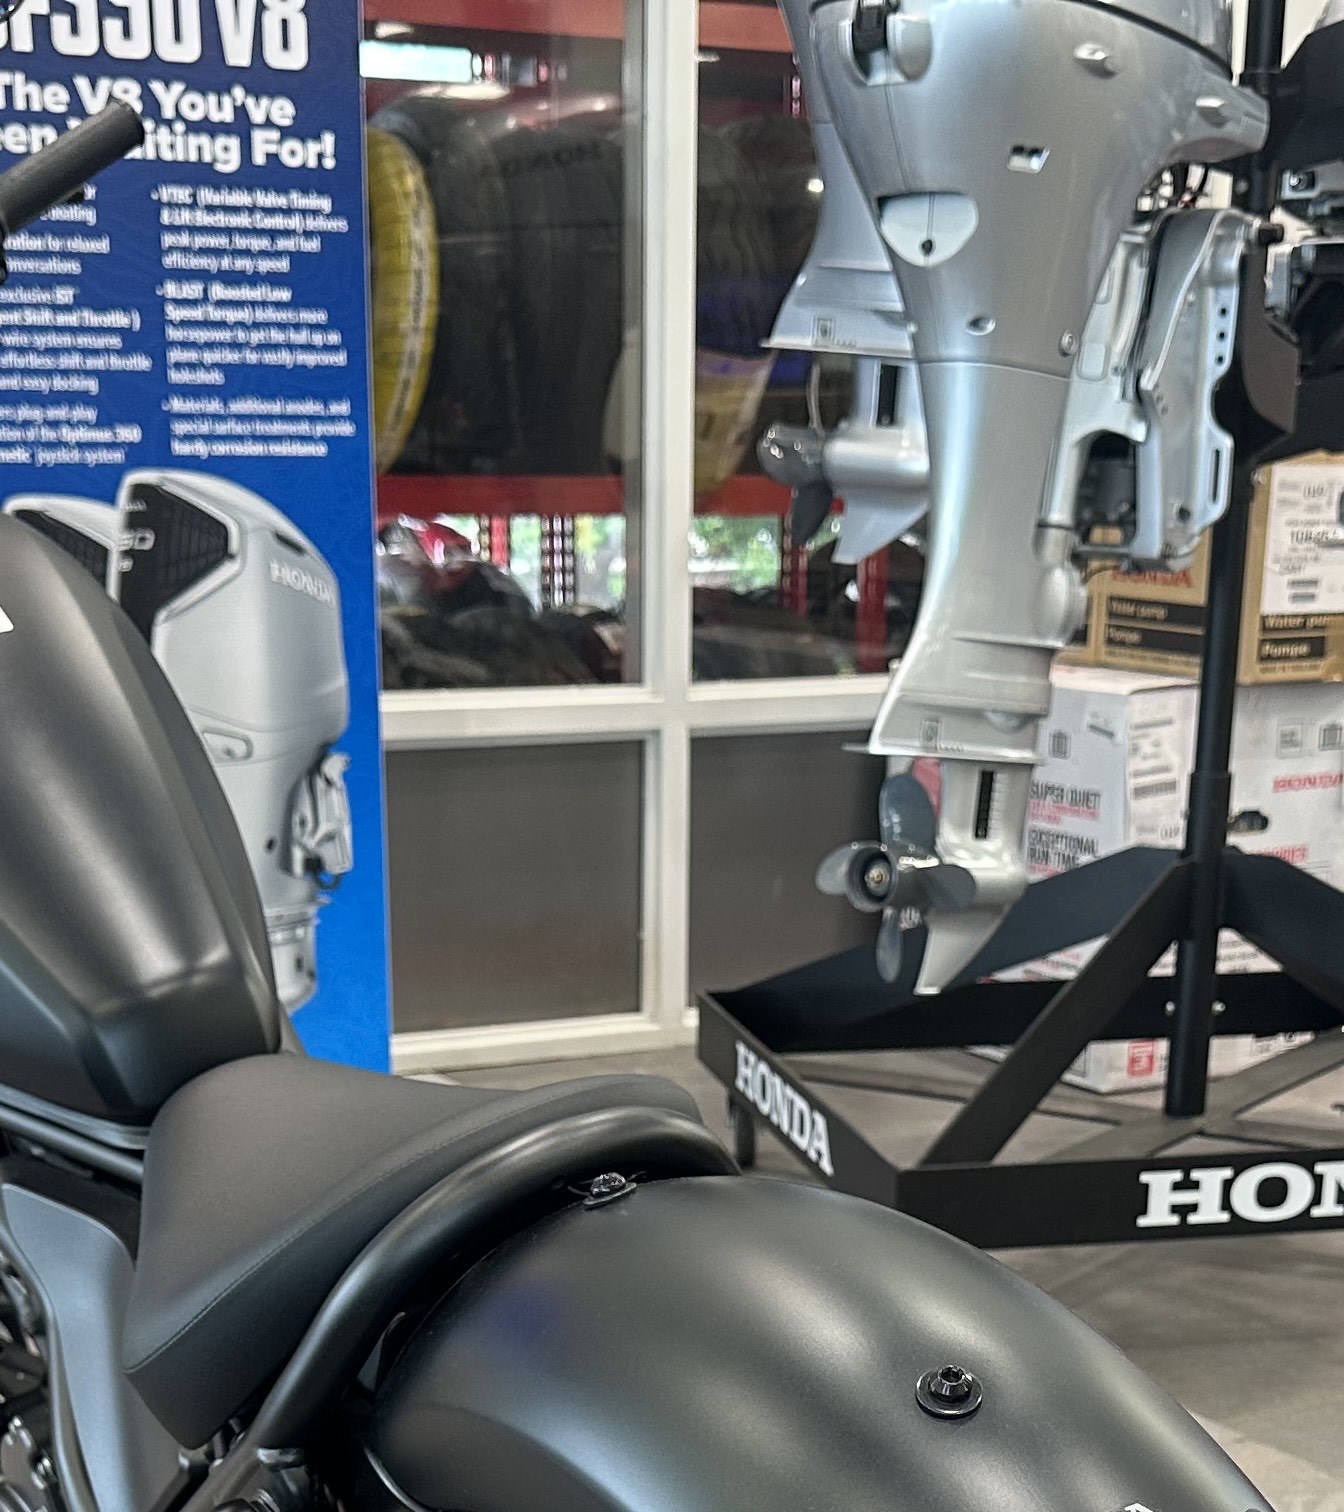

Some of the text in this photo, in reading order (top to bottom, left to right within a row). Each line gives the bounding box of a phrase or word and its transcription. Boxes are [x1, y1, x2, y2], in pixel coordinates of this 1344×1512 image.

[72, 73, 144, 115] V8
[148, 79, 297, 128] You've
[67, 118, 241, 174] iting
[250, 127, 337, 171] For!
[735, 1039, 834, 1177] HONDA
